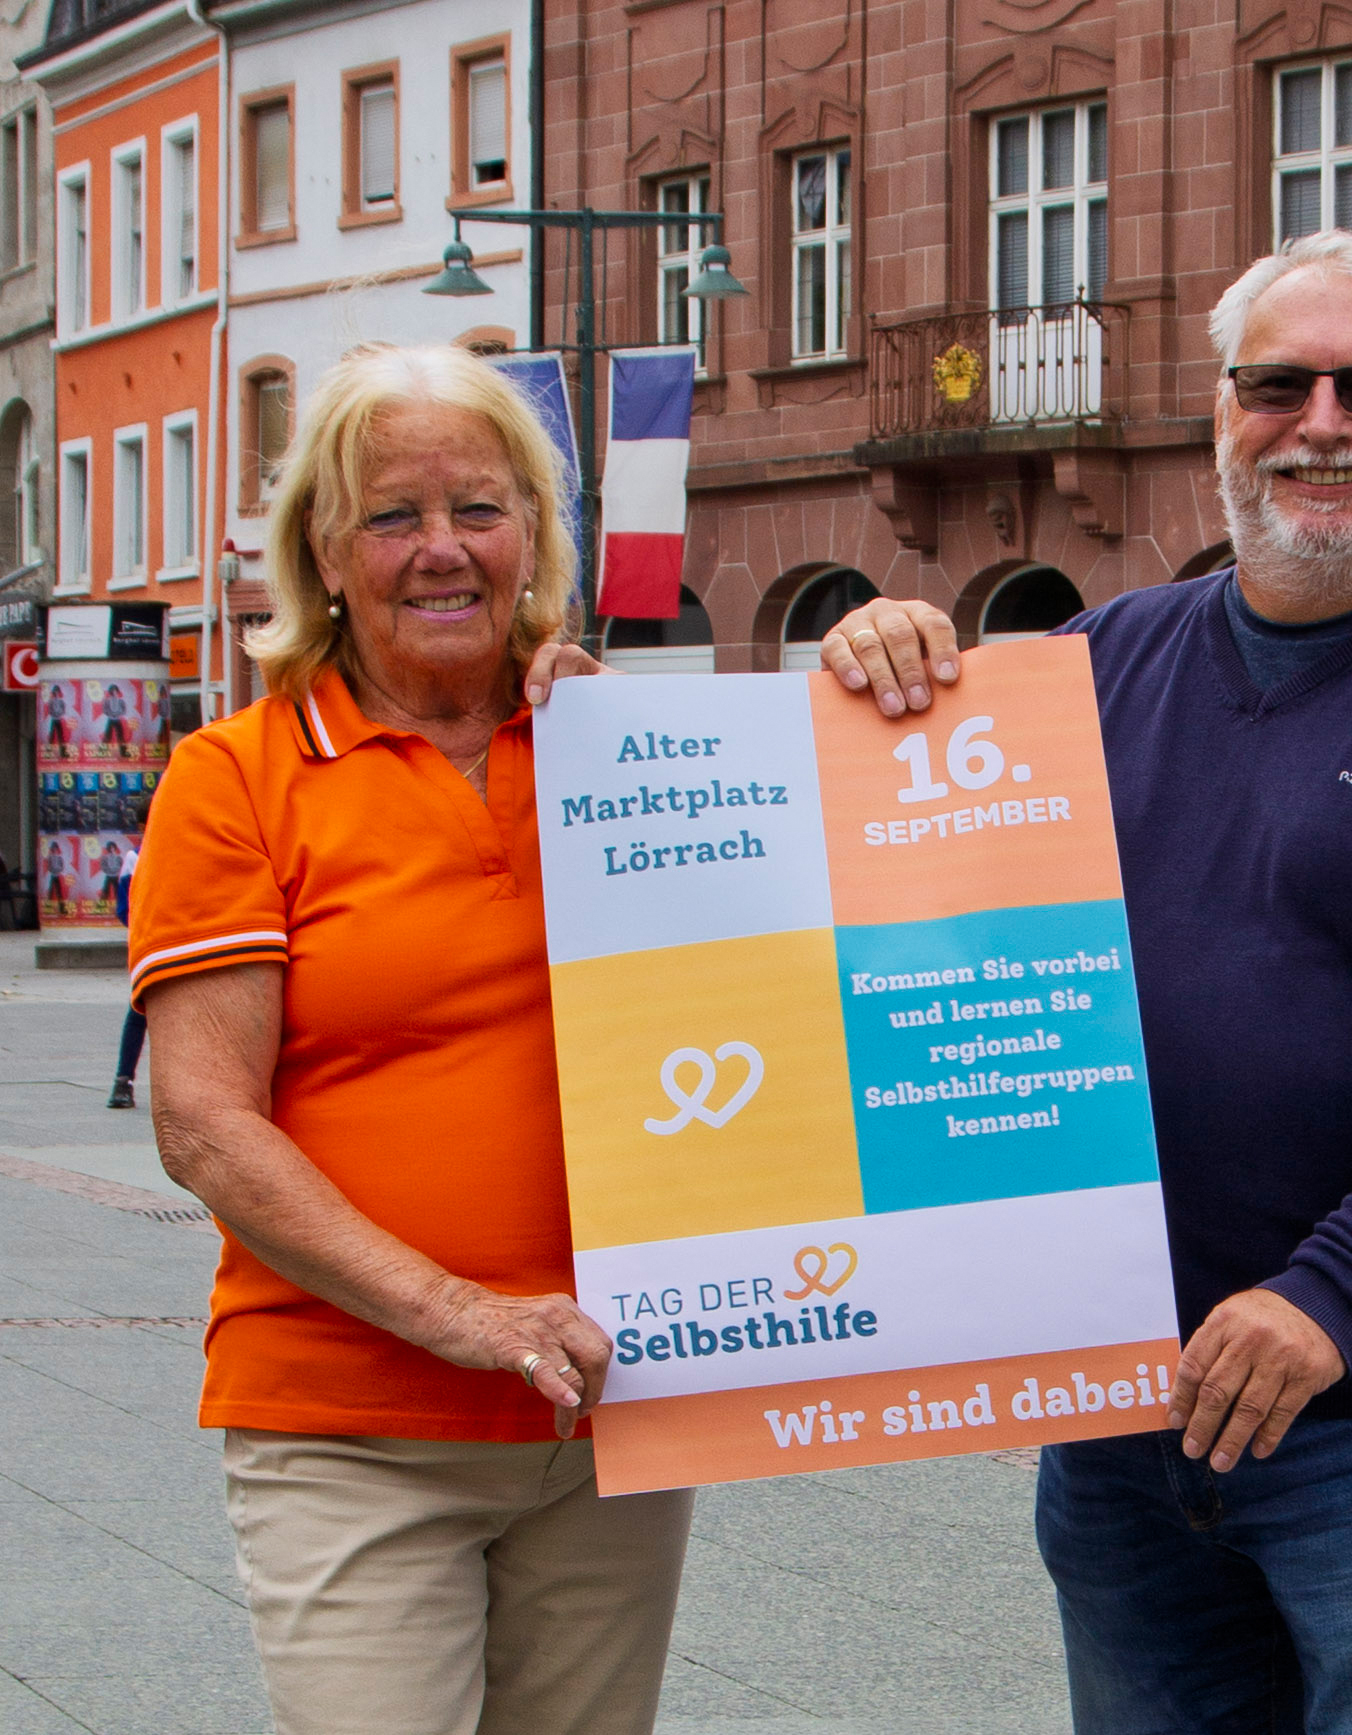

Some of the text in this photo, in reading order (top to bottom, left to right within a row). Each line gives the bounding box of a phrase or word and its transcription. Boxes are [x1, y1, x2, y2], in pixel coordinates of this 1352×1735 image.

[617, 732, 721, 763] Alter
[893, 715, 1032, 803] 16.
[562, 779, 788, 827] Marktplatz
[864, 796, 1072, 846] SEPTEMBER
[604, 830, 766, 876] Lörrach
[852, 948, 1121, 995] Kommen Sie vorbei
[889, 988, 1092, 1029] und lernen Sie
[929, 1028, 1062, 1065] regionale
[864, 1064, 1135, 1109] Selbsthilfegruppen
[946, 1104, 1060, 1137] kennen!
[611, 1277, 775, 1321] TAG DER
[616, 1303, 878, 1365] Selbsthilfe
[763, 1364, 1170, 1448] Wir sind dabei!
